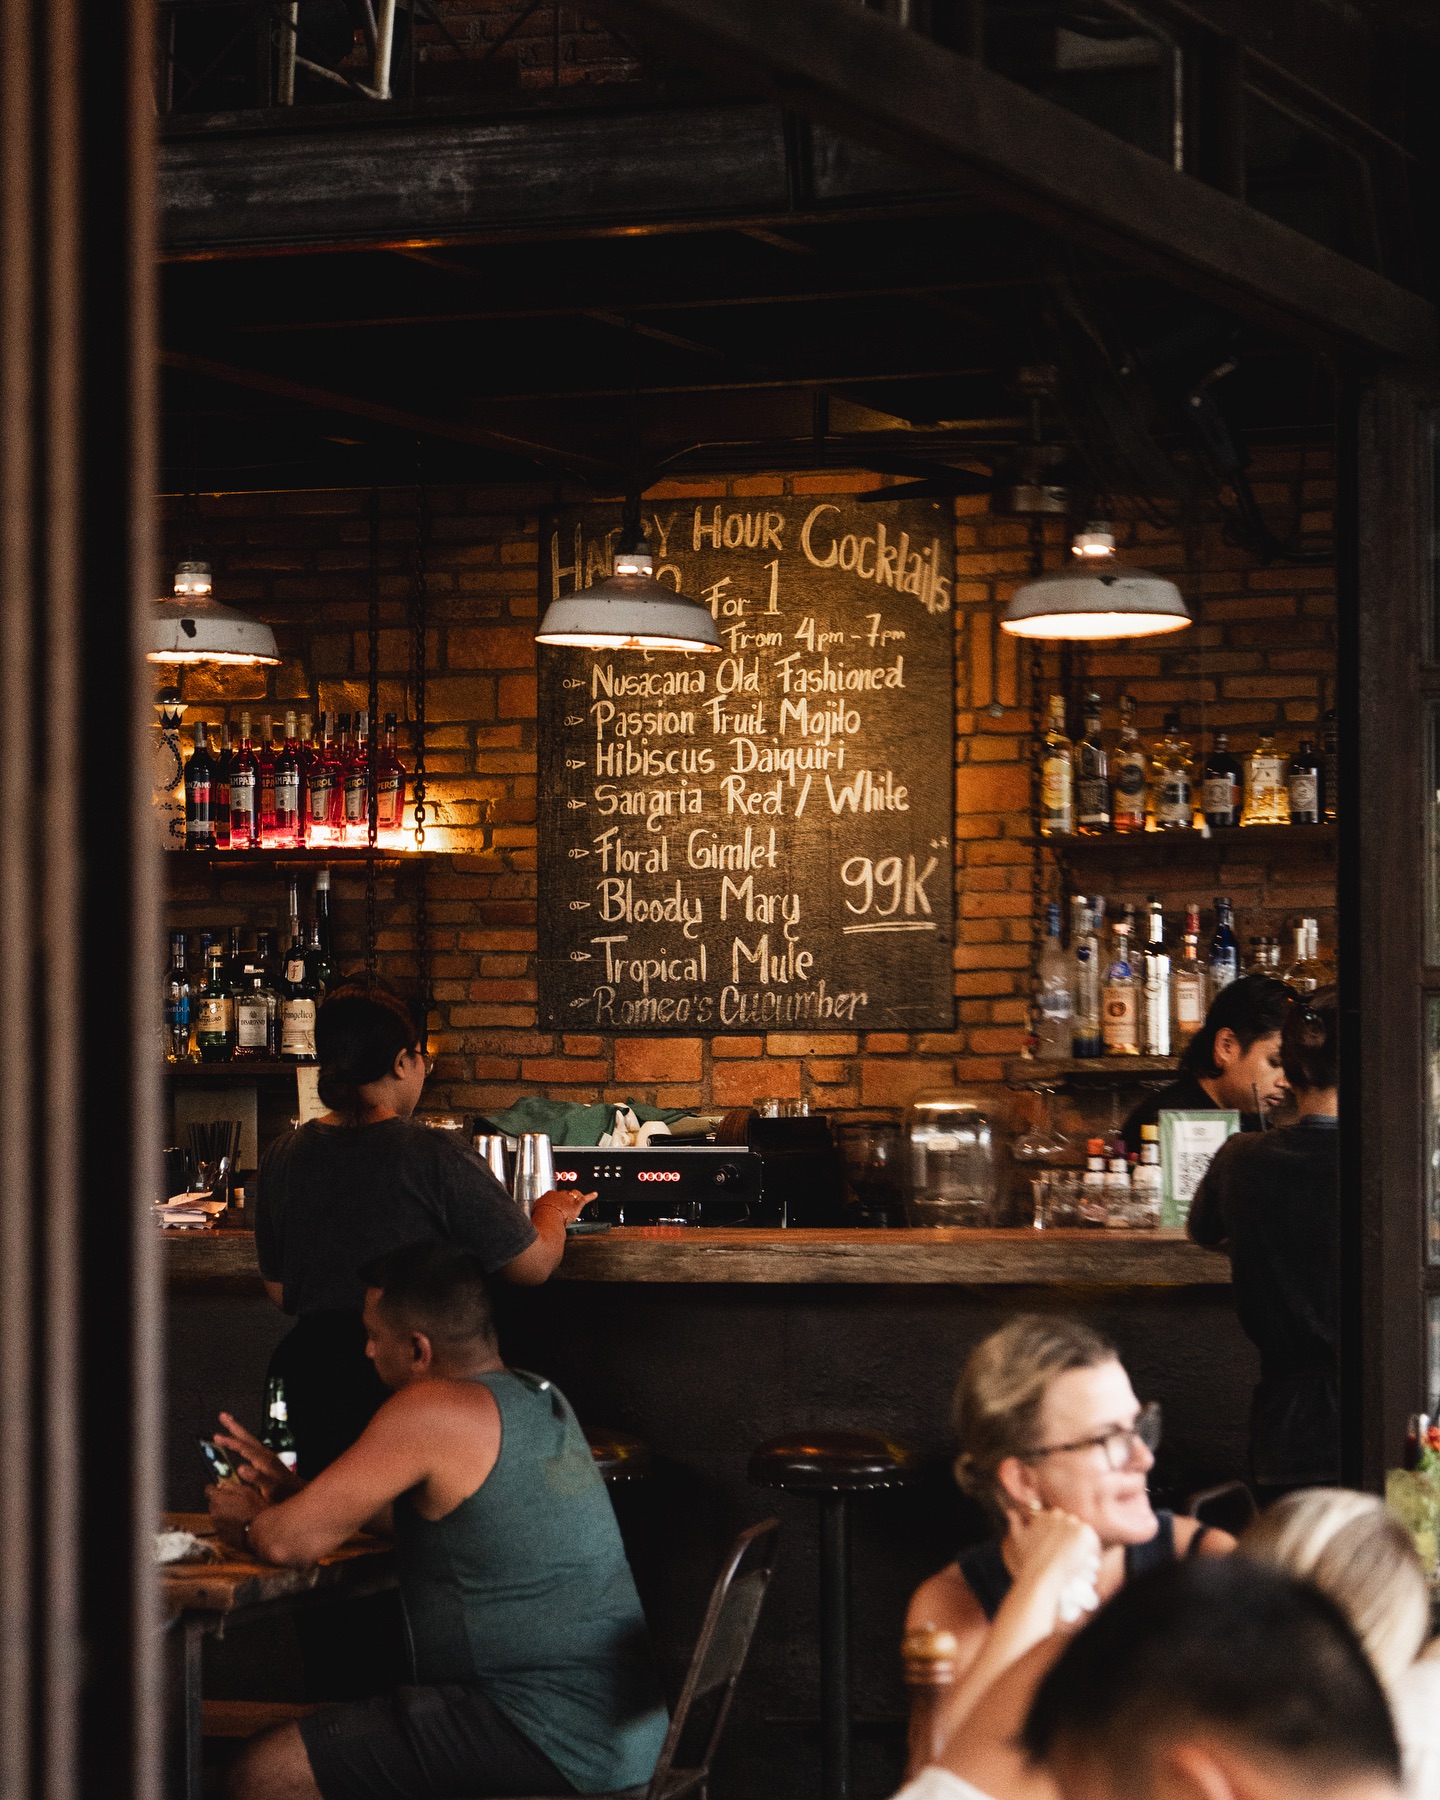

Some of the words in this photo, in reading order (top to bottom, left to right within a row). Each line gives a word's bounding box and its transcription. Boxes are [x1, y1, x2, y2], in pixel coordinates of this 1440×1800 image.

[551, 511, 679, 600] HAY
[693, 505, 784, 550] HOUR
[801, 503, 951, 614] Cocktails
[701, 577, 750, 619] For
[763, 560, 784, 615] 1
[721, 621, 782, 653] From
[591, 664, 705, 699] Nusacana
[716, 657, 760, 694] Old
[774, 652, 905, 693] Fashioned
[590, 700, 694, 740] Passion
[702, 694, 767, 735] Fruit
[780, 697, 861, 746] Mojito
[597, 738, 715, 777] Hibiscus
[728, 737, 844, 787] Daiquiri
[595, 779, 702, 832] Sangria
[720, 774, 784, 815] Red
[825, 769, 910, 814] White
[593, 826, 668, 873] Floral
[688, 826, 778, 871] Gimlet
[597, 878, 702, 939] Bloody
[720, 875, 800, 941] Mary
[590, 935, 706, 993] Tropical
[732, 934, 814, 984] Mule
[593, 986, 713, 1025] Romeo's
[720, 979, 868, 1025] Cucumber
